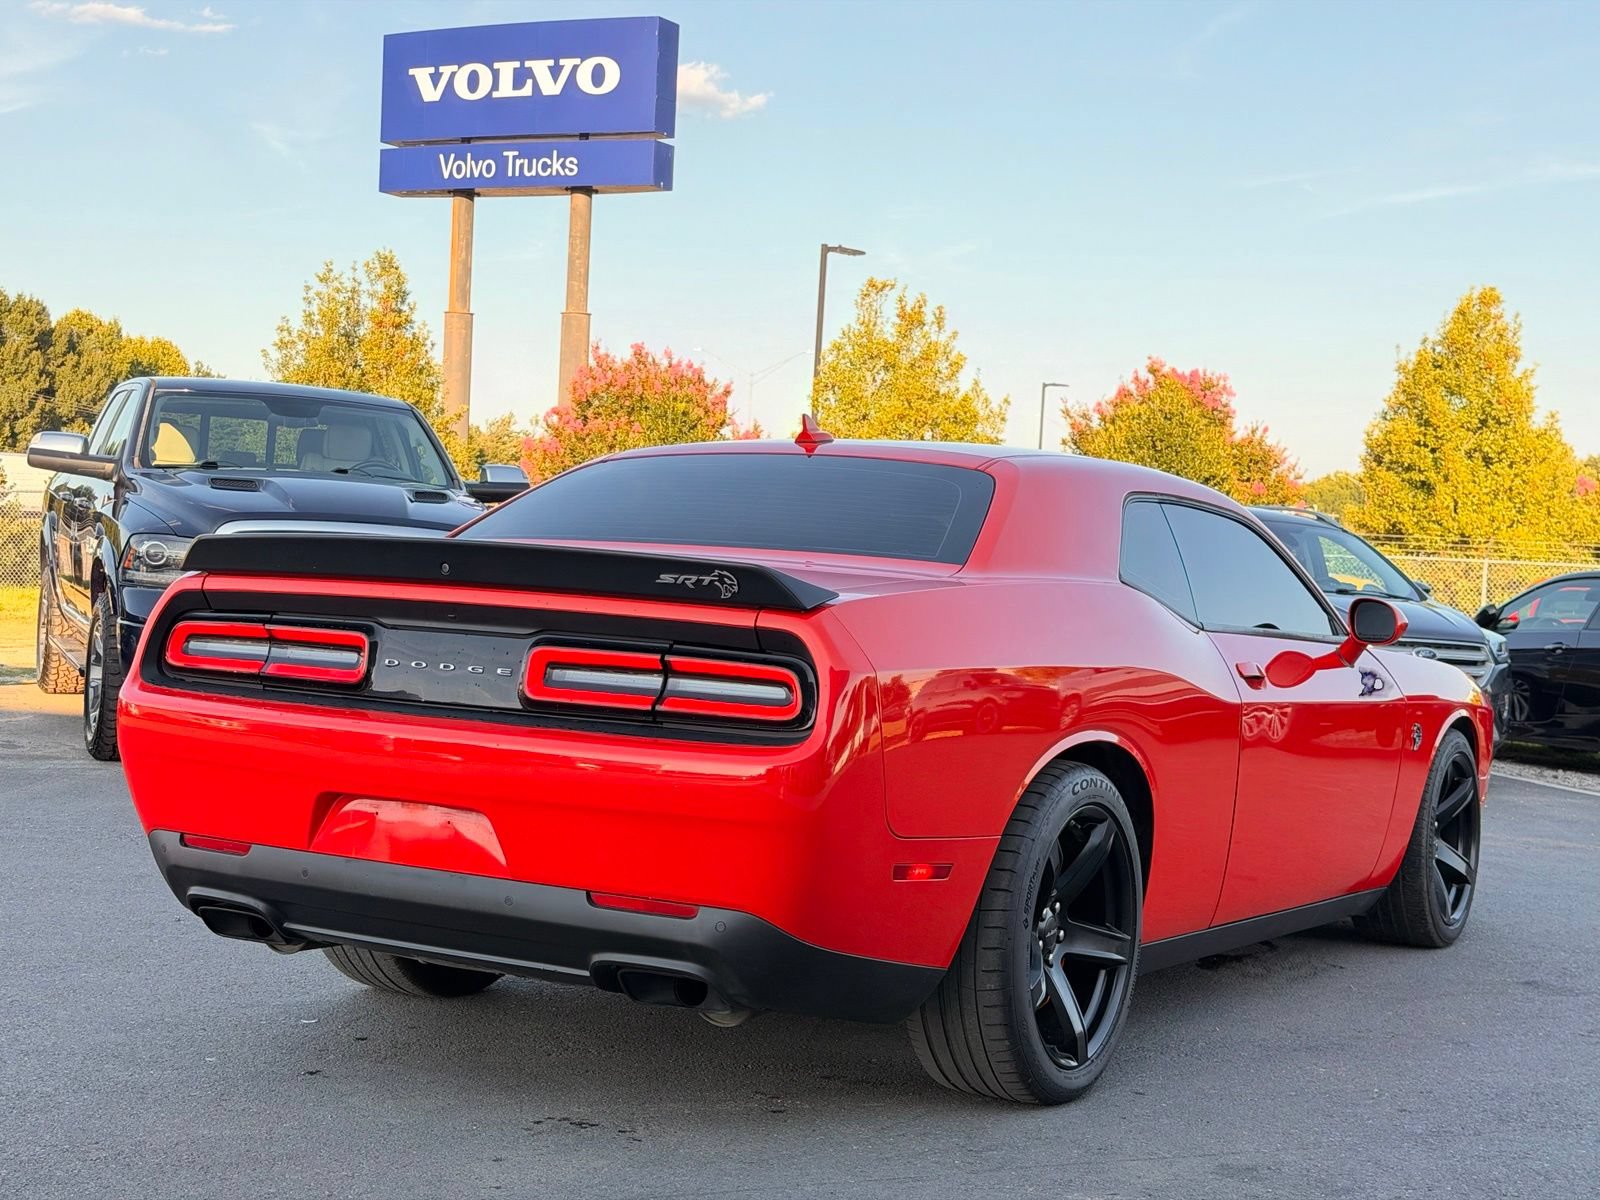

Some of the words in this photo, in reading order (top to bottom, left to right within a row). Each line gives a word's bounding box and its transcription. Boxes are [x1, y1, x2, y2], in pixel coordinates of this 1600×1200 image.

[408, 56, 621, 103] VOLVO
[439, 152, 496, 180] Volvo
[502, 150, 579, 177] Trucks
[655, 573, 719, 589] SRT
[384, 658, 513, 676] DODGE
